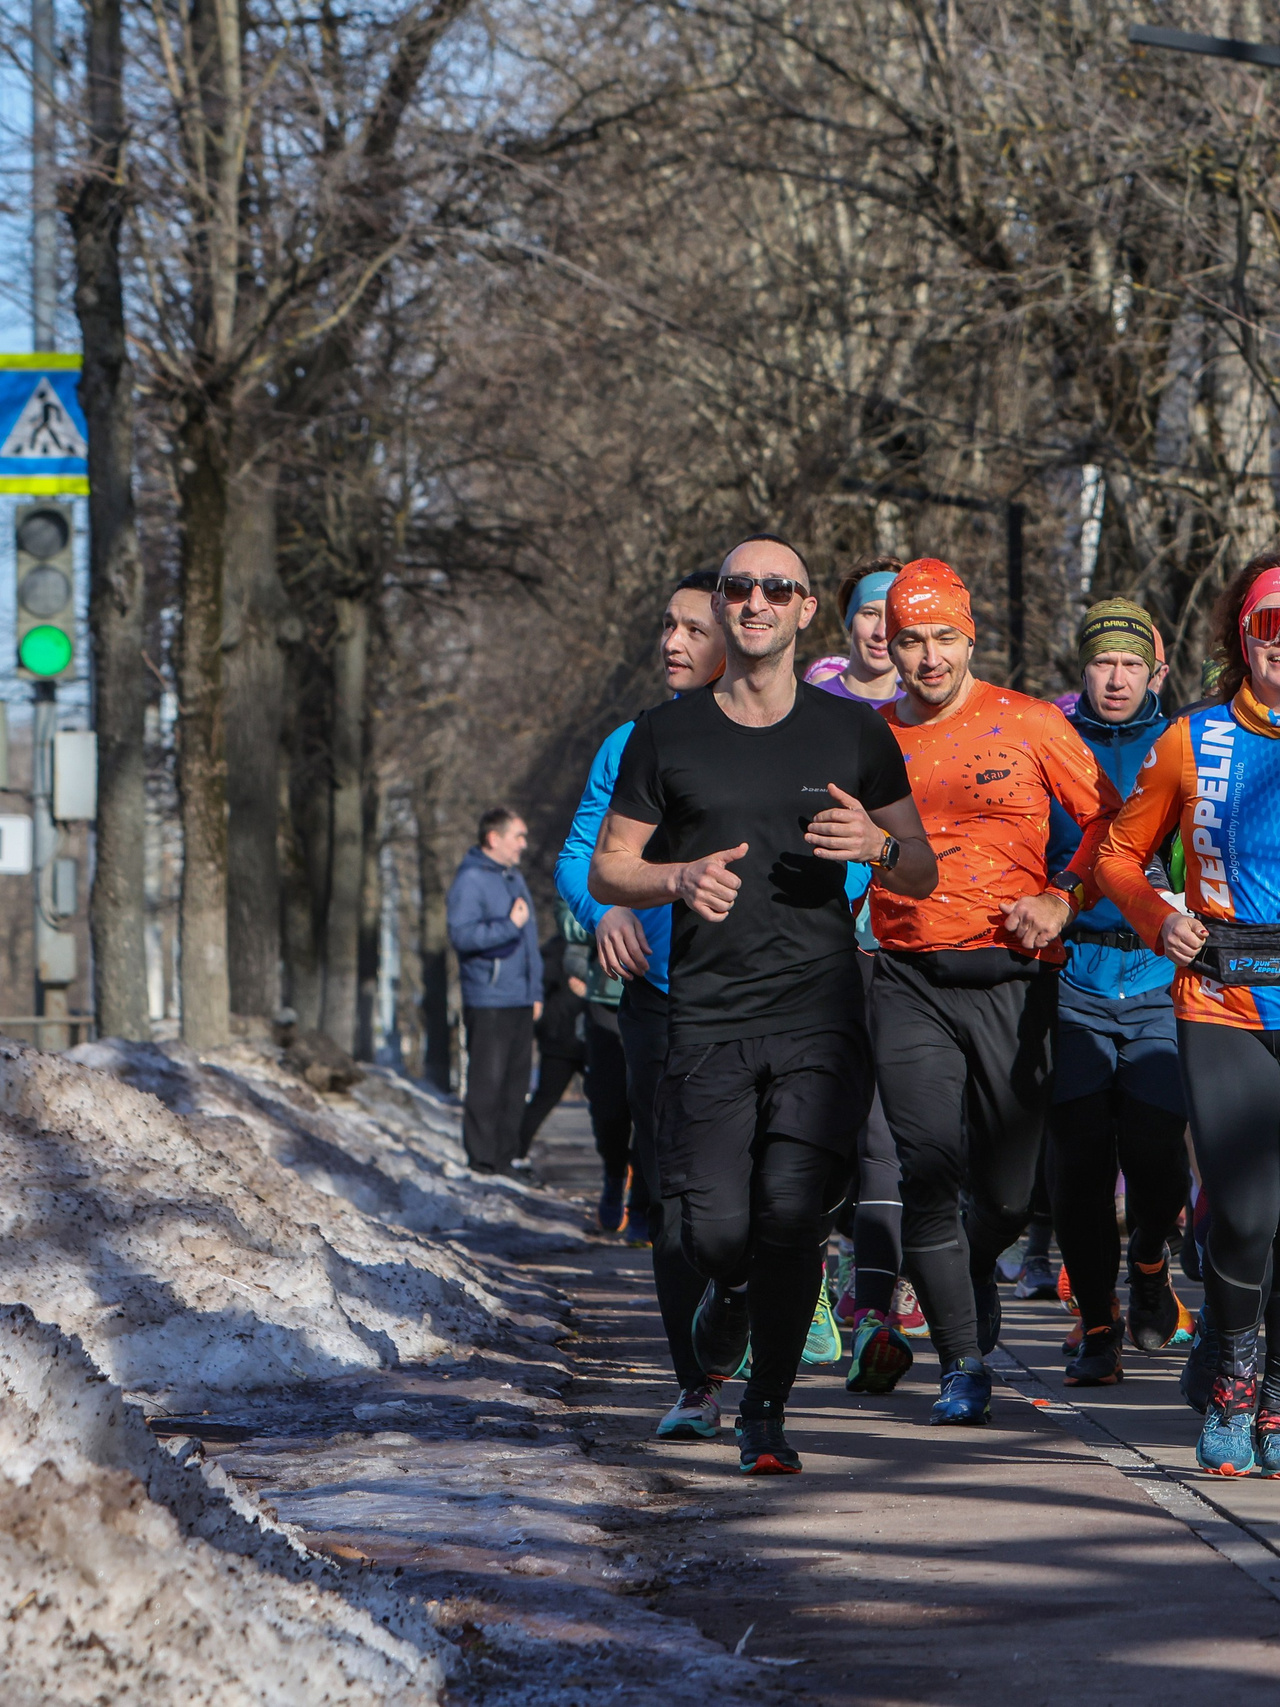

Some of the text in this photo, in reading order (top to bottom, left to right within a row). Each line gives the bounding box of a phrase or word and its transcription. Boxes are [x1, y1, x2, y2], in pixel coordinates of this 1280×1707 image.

[1234, 761, 1245, 781] club
[1192, 719, 1237, 909] ZEPPELIN
[1231, 780, 1245, 817] running
